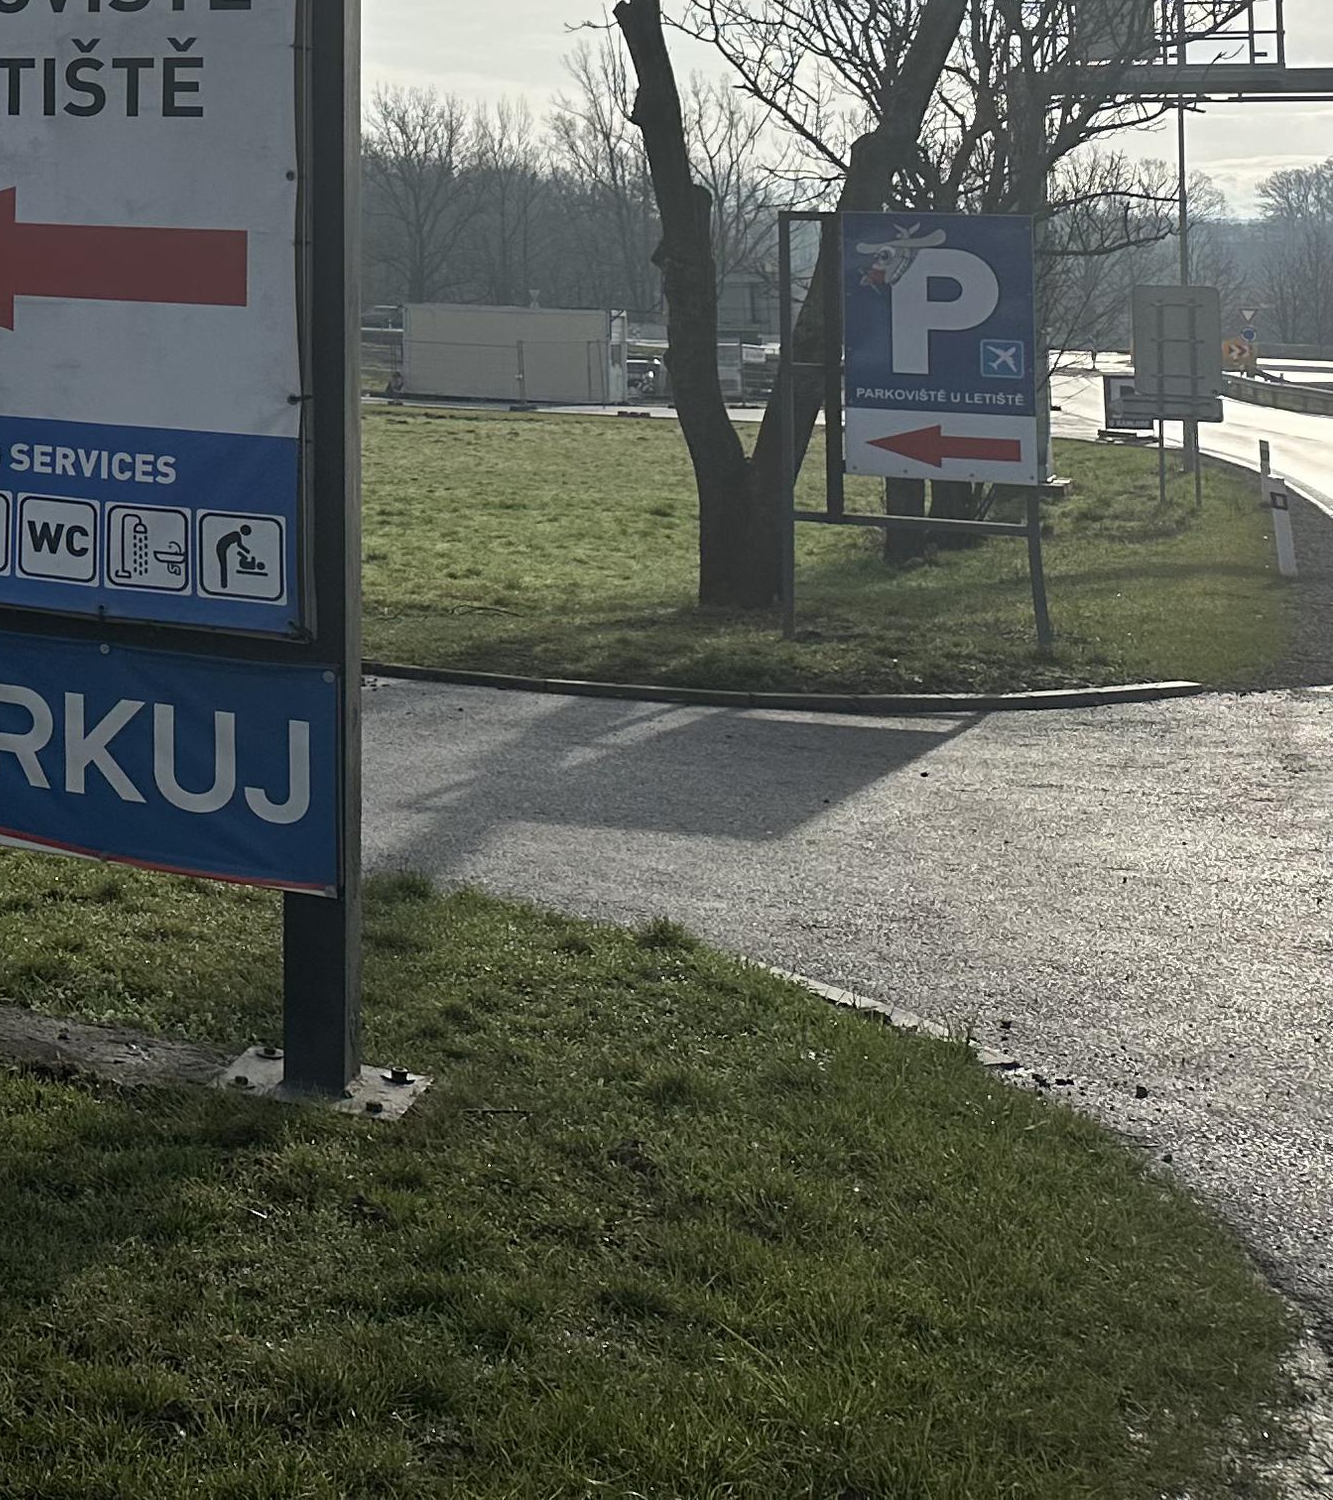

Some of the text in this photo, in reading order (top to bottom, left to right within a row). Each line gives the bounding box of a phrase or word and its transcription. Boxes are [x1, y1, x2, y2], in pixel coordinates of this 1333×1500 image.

[891, 248, 999, 375] P
[856, 387, 1025, 406] PARKOVIŠTĚ U LETIŠTĚ
[10, 442, 178, 485] SERVICES
[27, 520, 90, 558] WC
